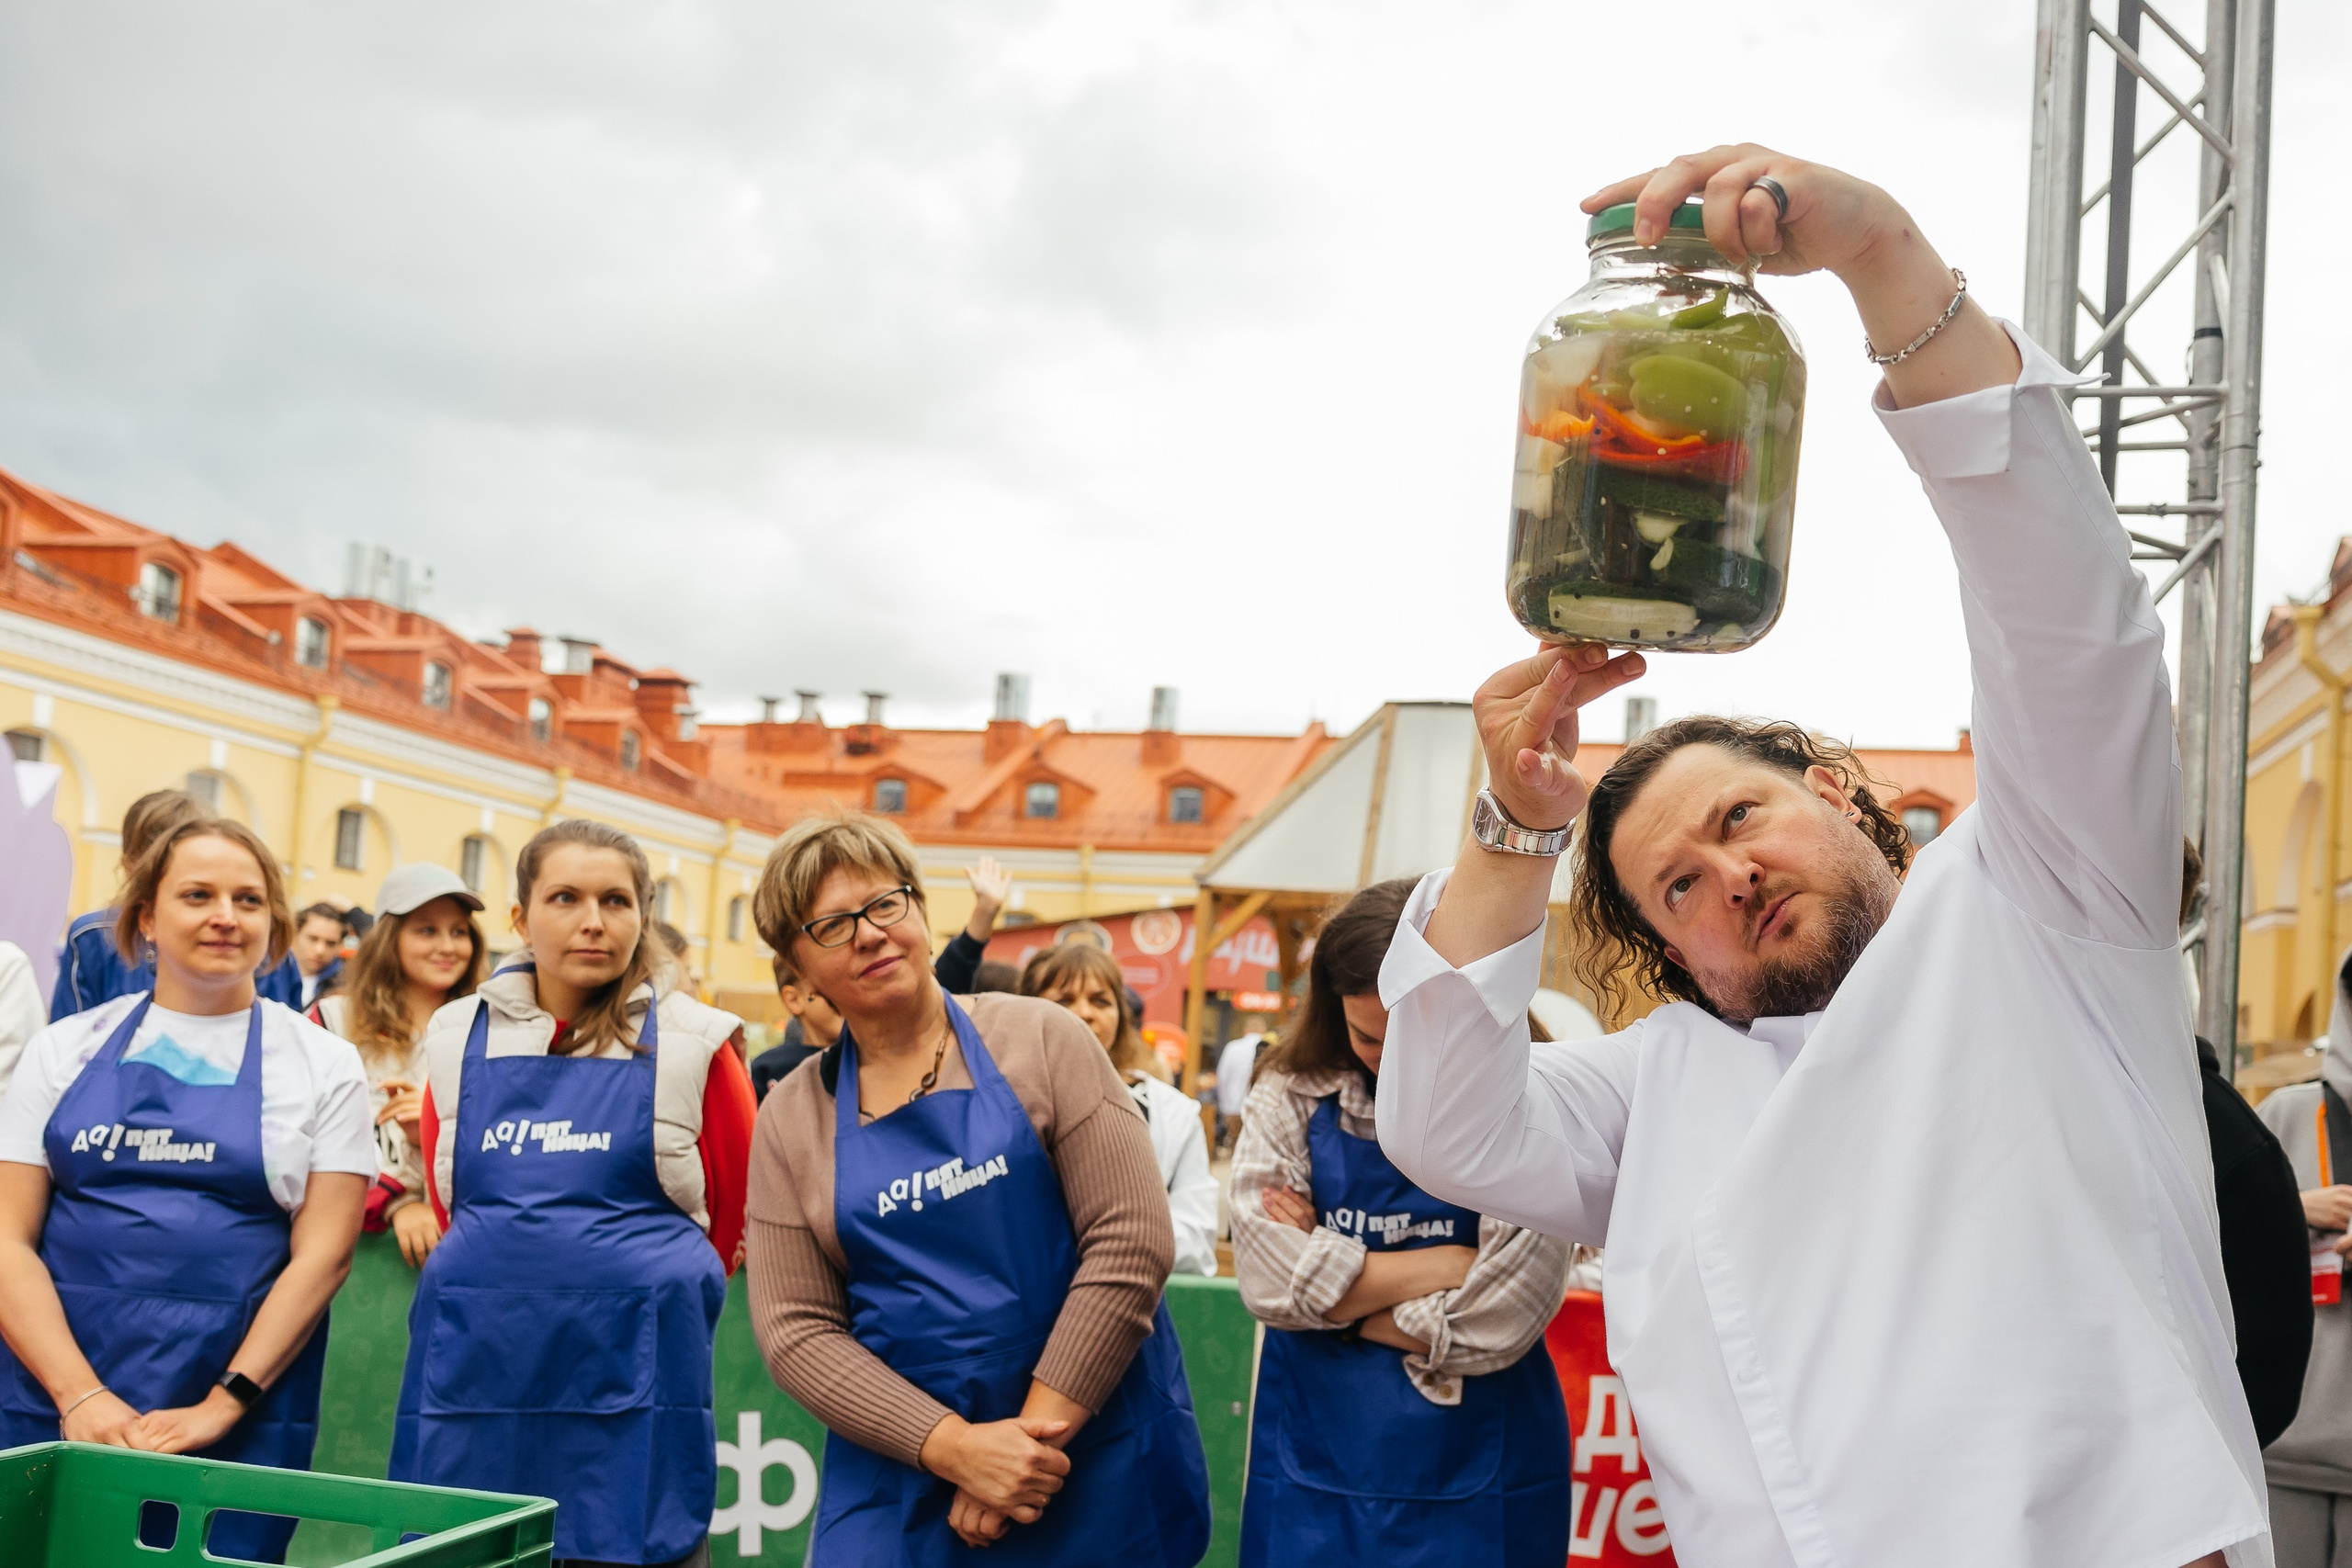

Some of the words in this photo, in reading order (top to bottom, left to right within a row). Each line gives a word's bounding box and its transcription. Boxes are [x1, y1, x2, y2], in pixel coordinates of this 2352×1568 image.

[125, 1129, 174, 1146] ПЯТ
[530, 1121, 572, 1140] ПЯТ
[138, 1143, 217, 1163] НИЦА!
[542, 1133, 612, 1153] НИЦА!
[924, 1156, 963, 1190] ПЯТ
[940, 1154, 1009, 1201] НИЦА!
